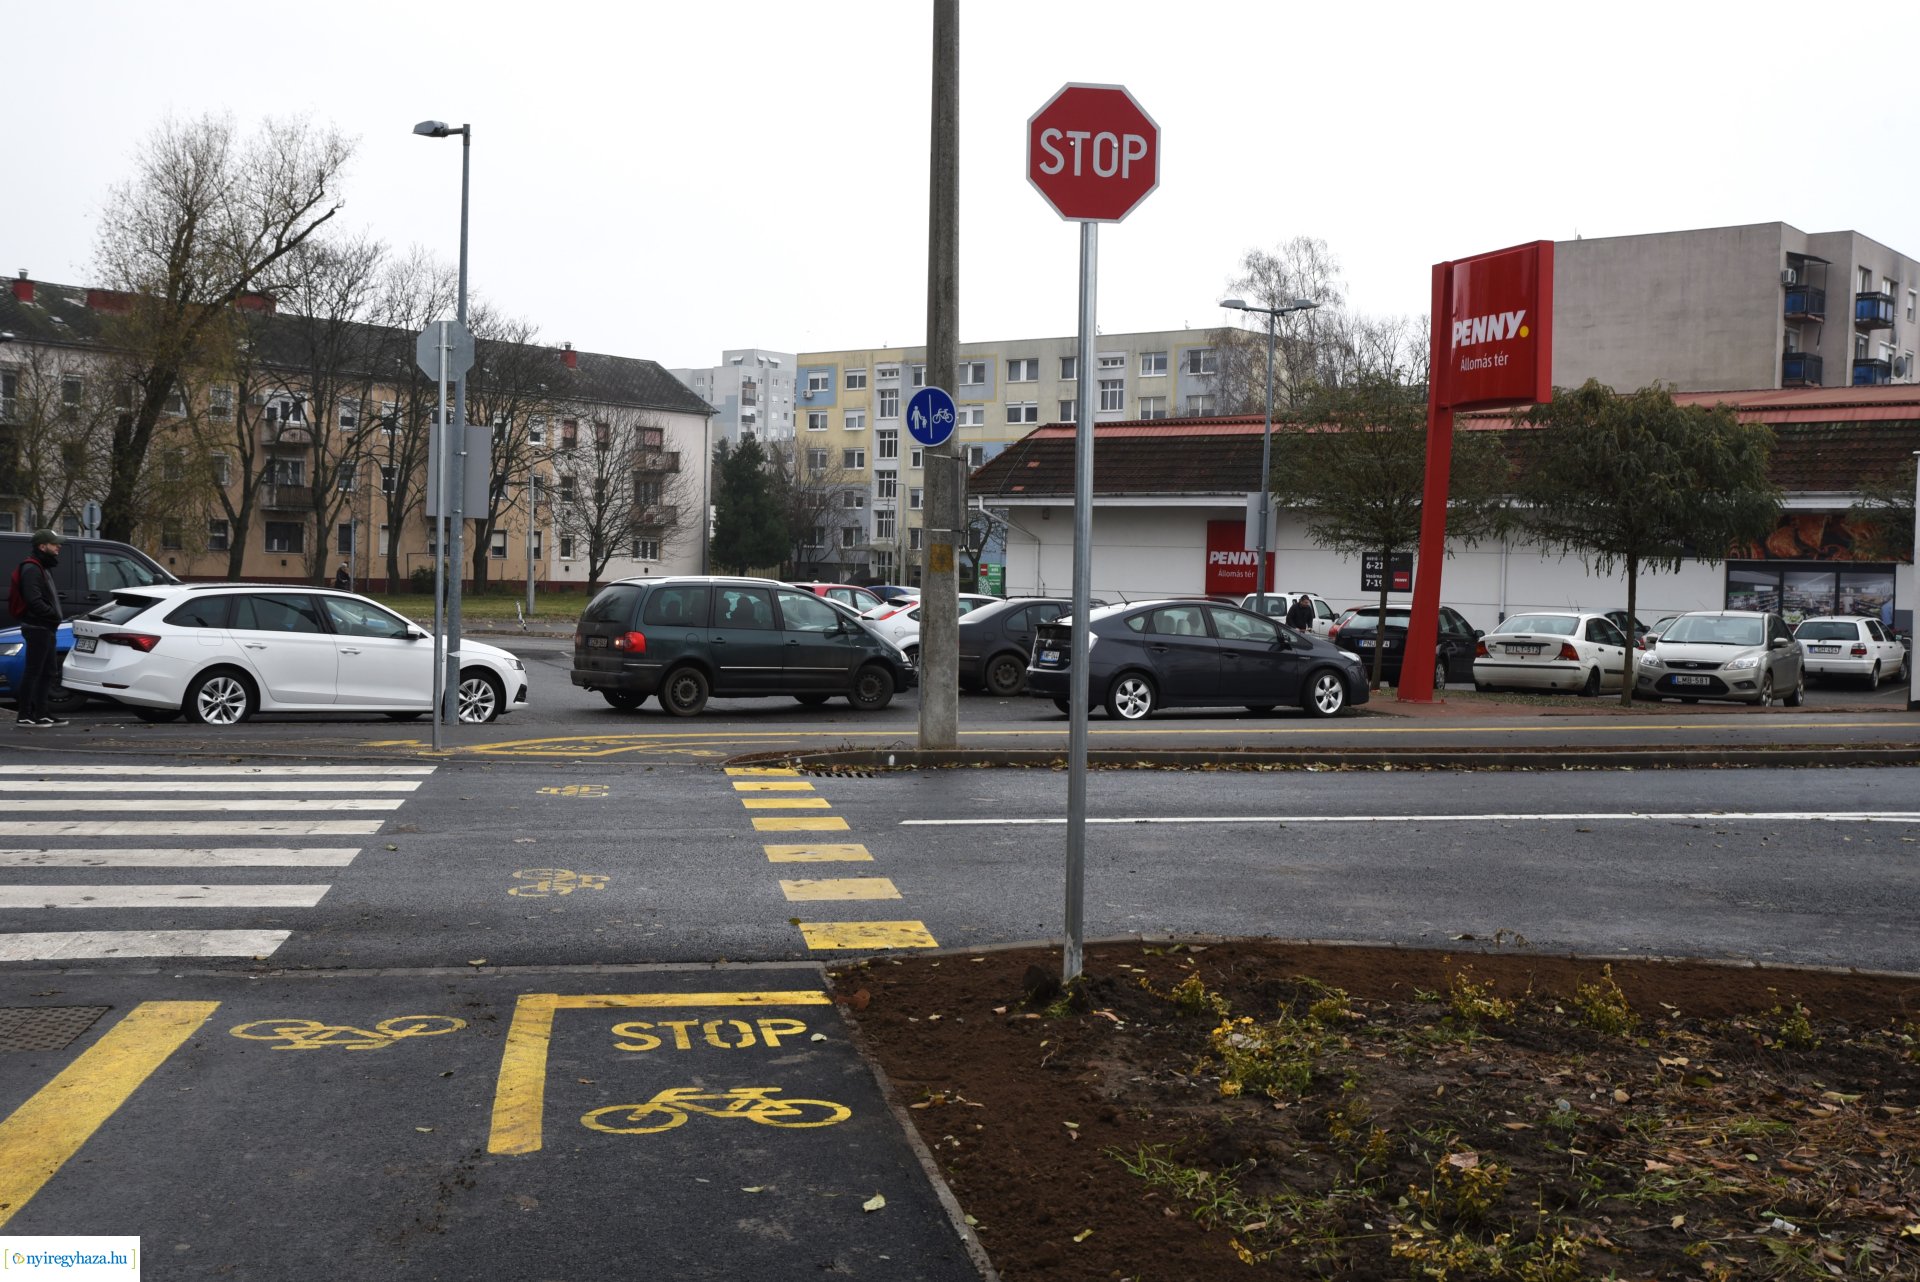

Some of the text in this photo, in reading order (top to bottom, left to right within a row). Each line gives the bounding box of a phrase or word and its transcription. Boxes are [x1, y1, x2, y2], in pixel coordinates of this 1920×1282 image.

[1039, 127, 1148, 179] STOP
[1460, 350, 1510, 372] Állomás tér
[1218, 568, 1255, 578] Állomás tér
[611, 1018, 808, 1051] STOP
